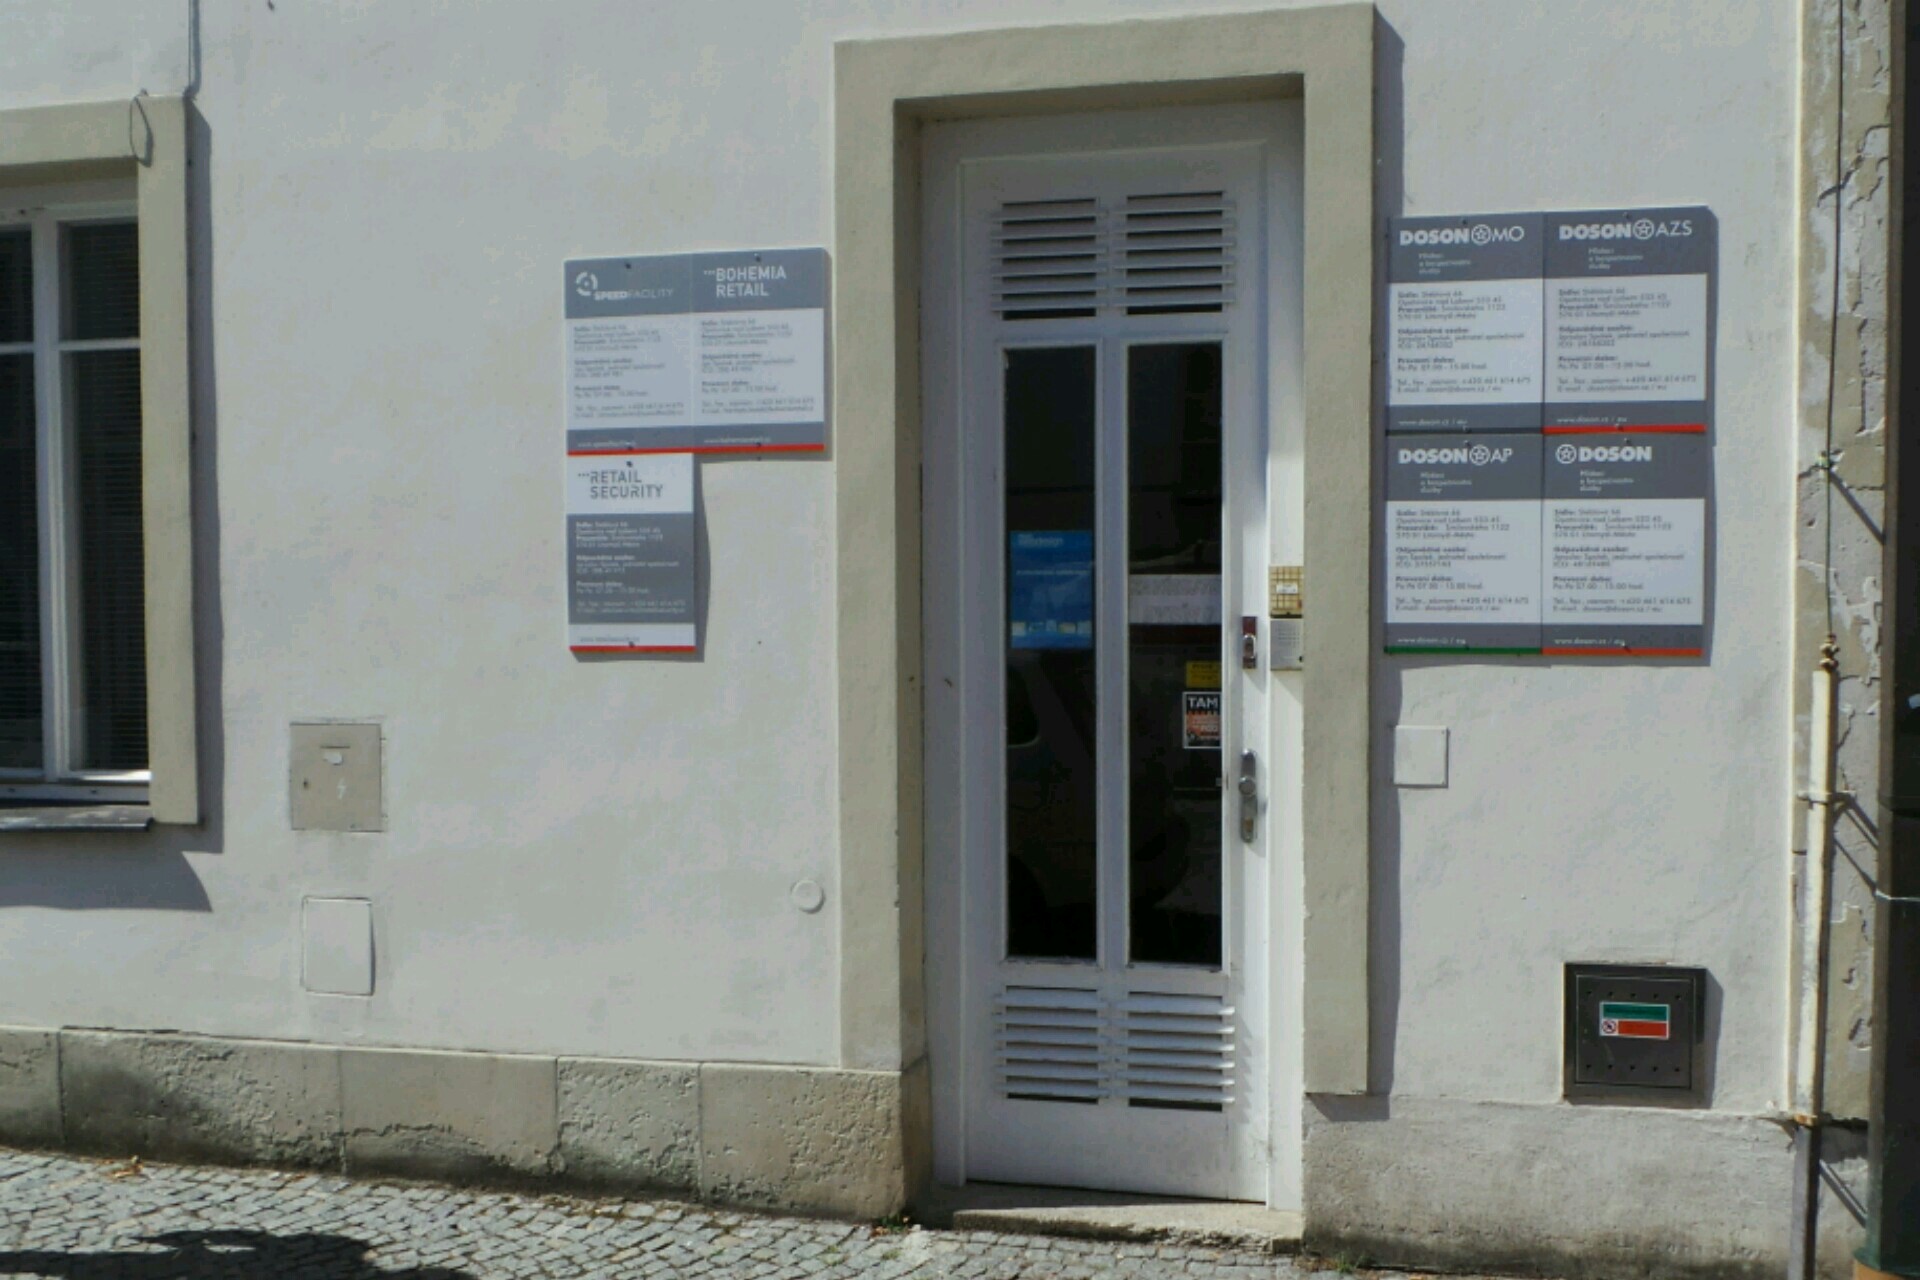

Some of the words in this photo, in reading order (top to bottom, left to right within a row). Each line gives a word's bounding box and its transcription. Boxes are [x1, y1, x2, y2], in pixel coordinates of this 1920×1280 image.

[1399, 228, 1469, 246] DOSON
[1492, 225, 1525, 243] MO
[1559, 222, 1632, 240] DOSON
[1655, 220, 1693, 237] AZS
[716, 265, 787, 282] BOHEMIA
[716, 283, 769, 298] RETAIL
[1398, 447, 1468, 465] DOSON
[1490, 447, 1513, 463] AP
[1578, 446, 1652, 462] DOSON
[590, 470, 642, 484] RETAIL
[590, 485, 663, 500] SECURITY
